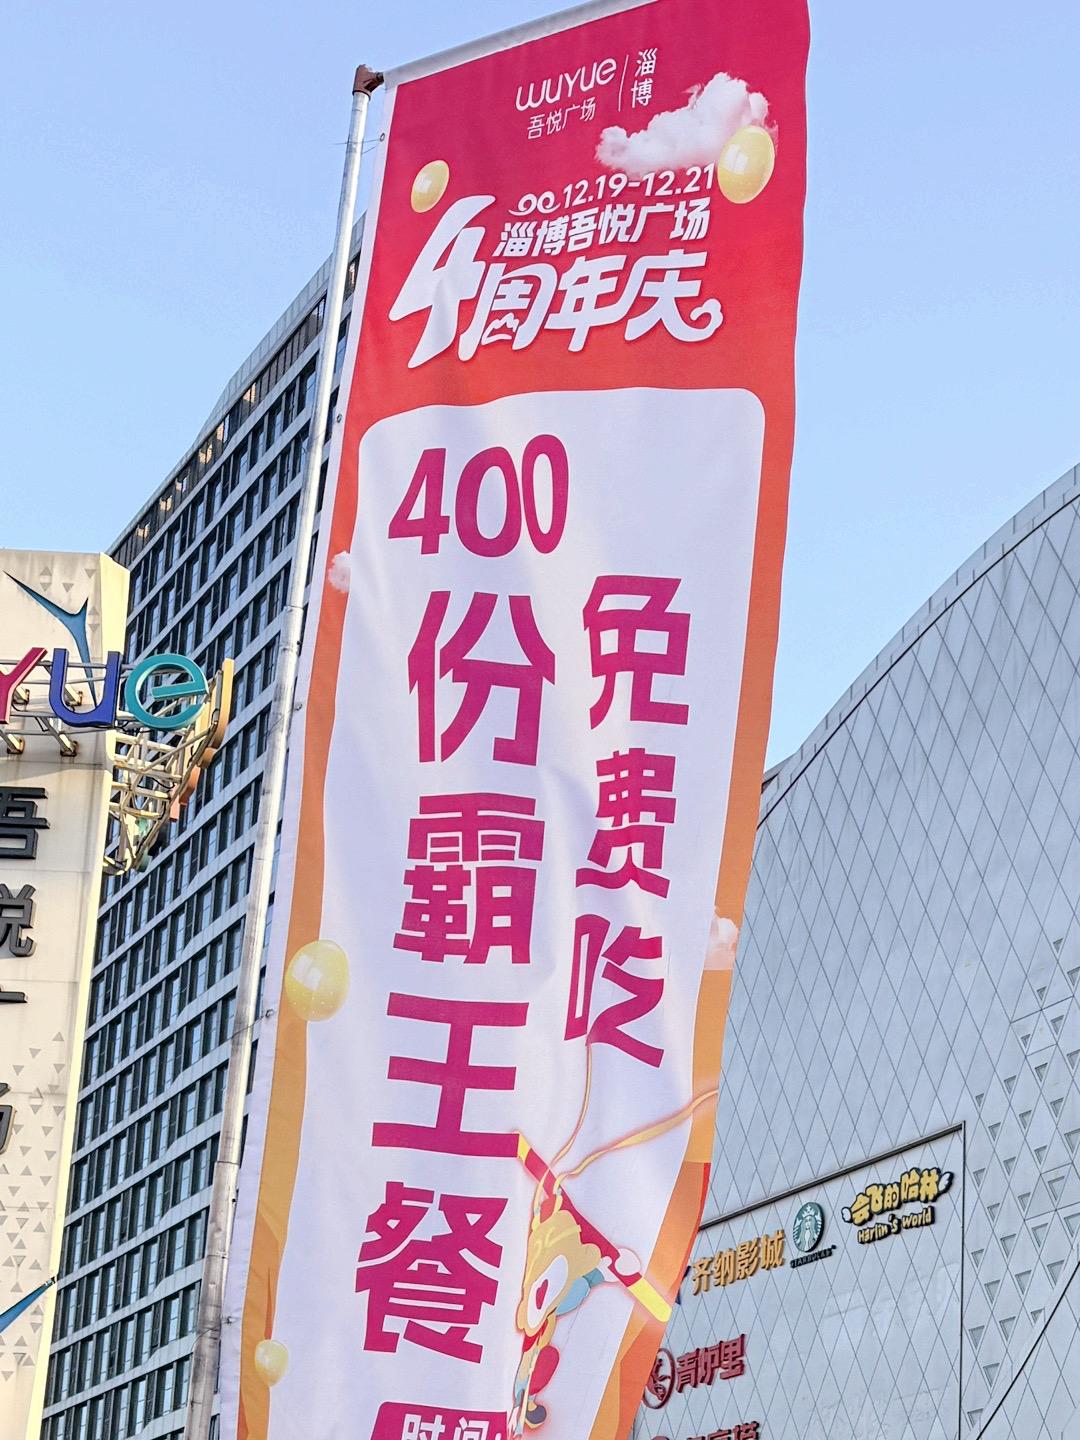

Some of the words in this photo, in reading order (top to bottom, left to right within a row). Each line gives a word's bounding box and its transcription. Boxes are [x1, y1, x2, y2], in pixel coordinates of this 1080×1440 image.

[631, 48, 658, 108] 淄博
[527, 97, 597, 140] 吾悦广场
[563, 163, 716, 209] 12.19-12.21
[492, 197, 711, 258] 淄博吾悦广场
[388, 194, 724, 369] 4周年庆
[564, 574, 692, 1068] 免费吃
[850, 1166, 941, 1227] 会飞的哈林
[692, 1229, 785, 1296] 齐纳影城
